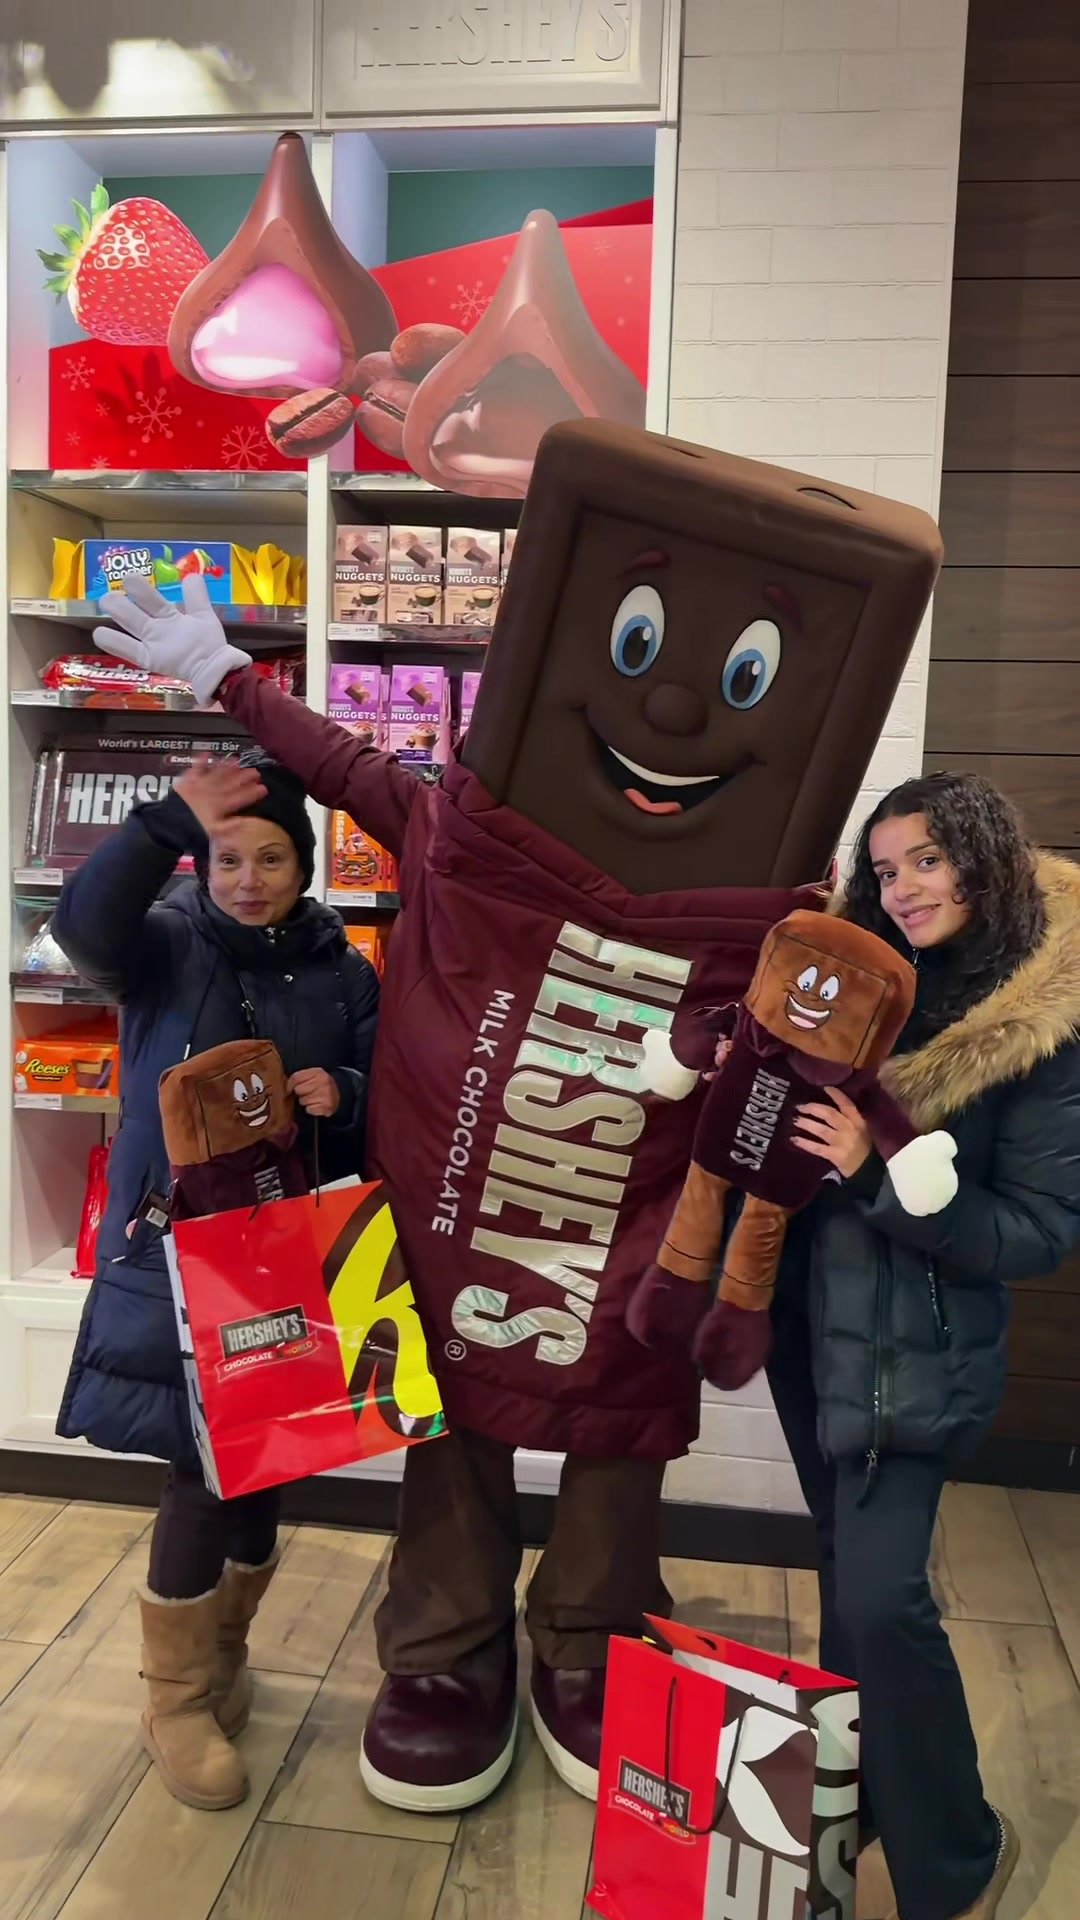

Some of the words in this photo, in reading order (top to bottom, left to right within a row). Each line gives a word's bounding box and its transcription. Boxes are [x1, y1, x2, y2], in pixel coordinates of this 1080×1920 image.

[105, 550, 148, 571] JOLLY
[335, 572, 385, 582] NUGGETS
[390, 573, 441, 583] NUGGETS
[448, 575, 498, 584] NUGGETS
[328, 711, 377, 720] NUGGETS
[391, 713, 439, 722] NUGGETS
[98, 738, 138, 748] World's
[140, 740, 190, 750] LARGEST
[222, 742, 240, 751] Bar
[472, 989, 515, 1059] MILK
[25, 1059, 70, 1075] Reese's
[730, 1067, 791, 1171] HERSHEY'S
[432, 1065, 488, 1236] CHOCOLATE
[450, 920, 694, 1366] HERSHEY'S
[227, 1314, 301, 1353] HERSHEY'S
[223, 1351, 273, 1372] CHOCOLATE
[614, 1794, 655, 1821] CHOCOLATE
